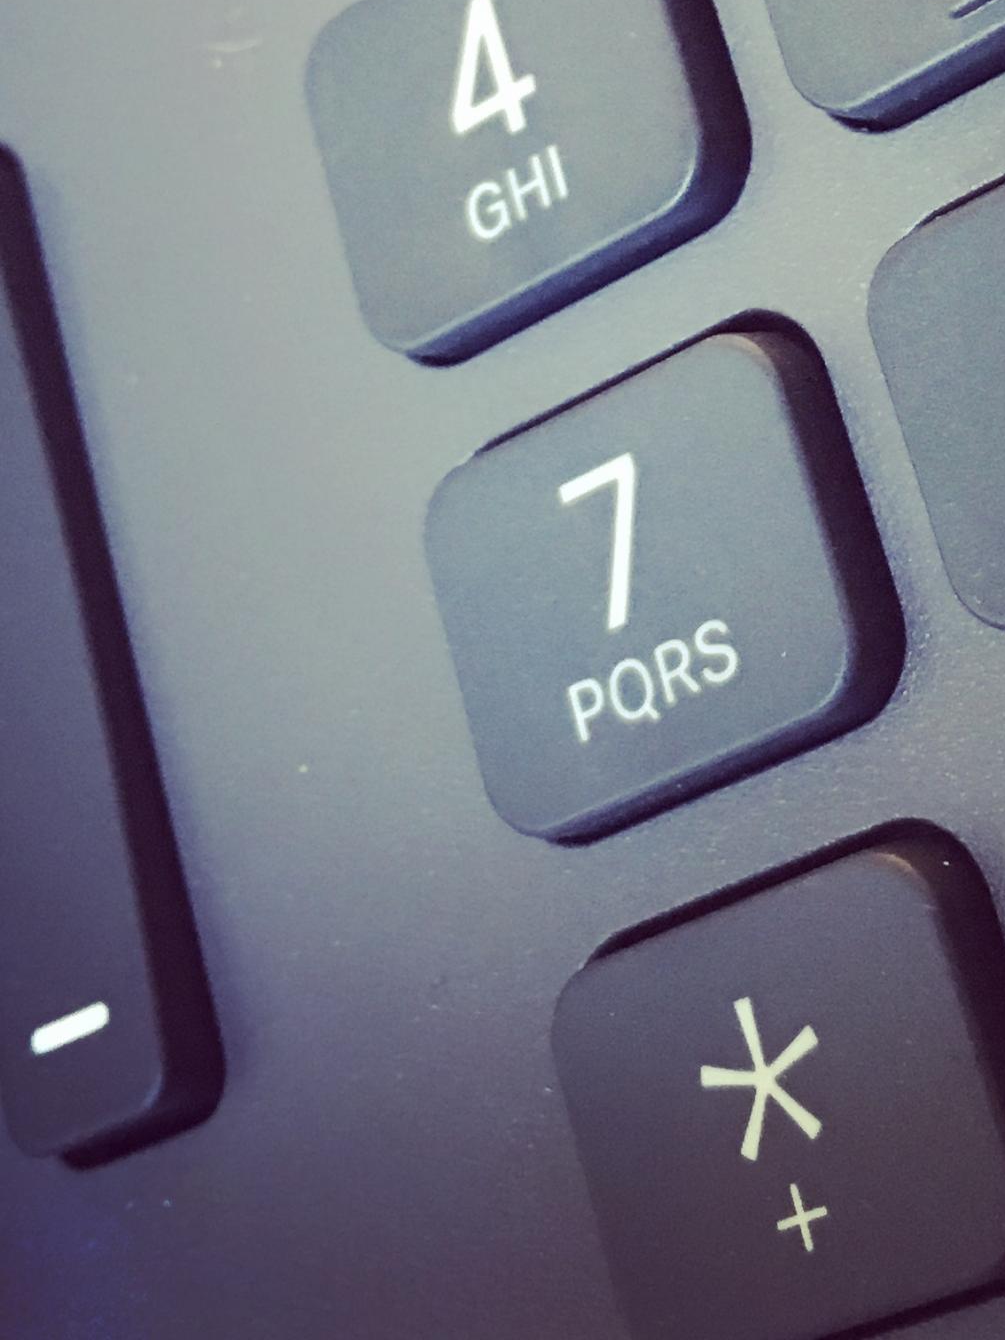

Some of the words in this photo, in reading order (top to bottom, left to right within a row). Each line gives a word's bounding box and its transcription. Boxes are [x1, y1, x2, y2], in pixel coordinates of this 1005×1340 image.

[466, 145, 569, 241] GHI
[557, 451, 637, 631] 7
[566, 618, 739, 744] PQRS
